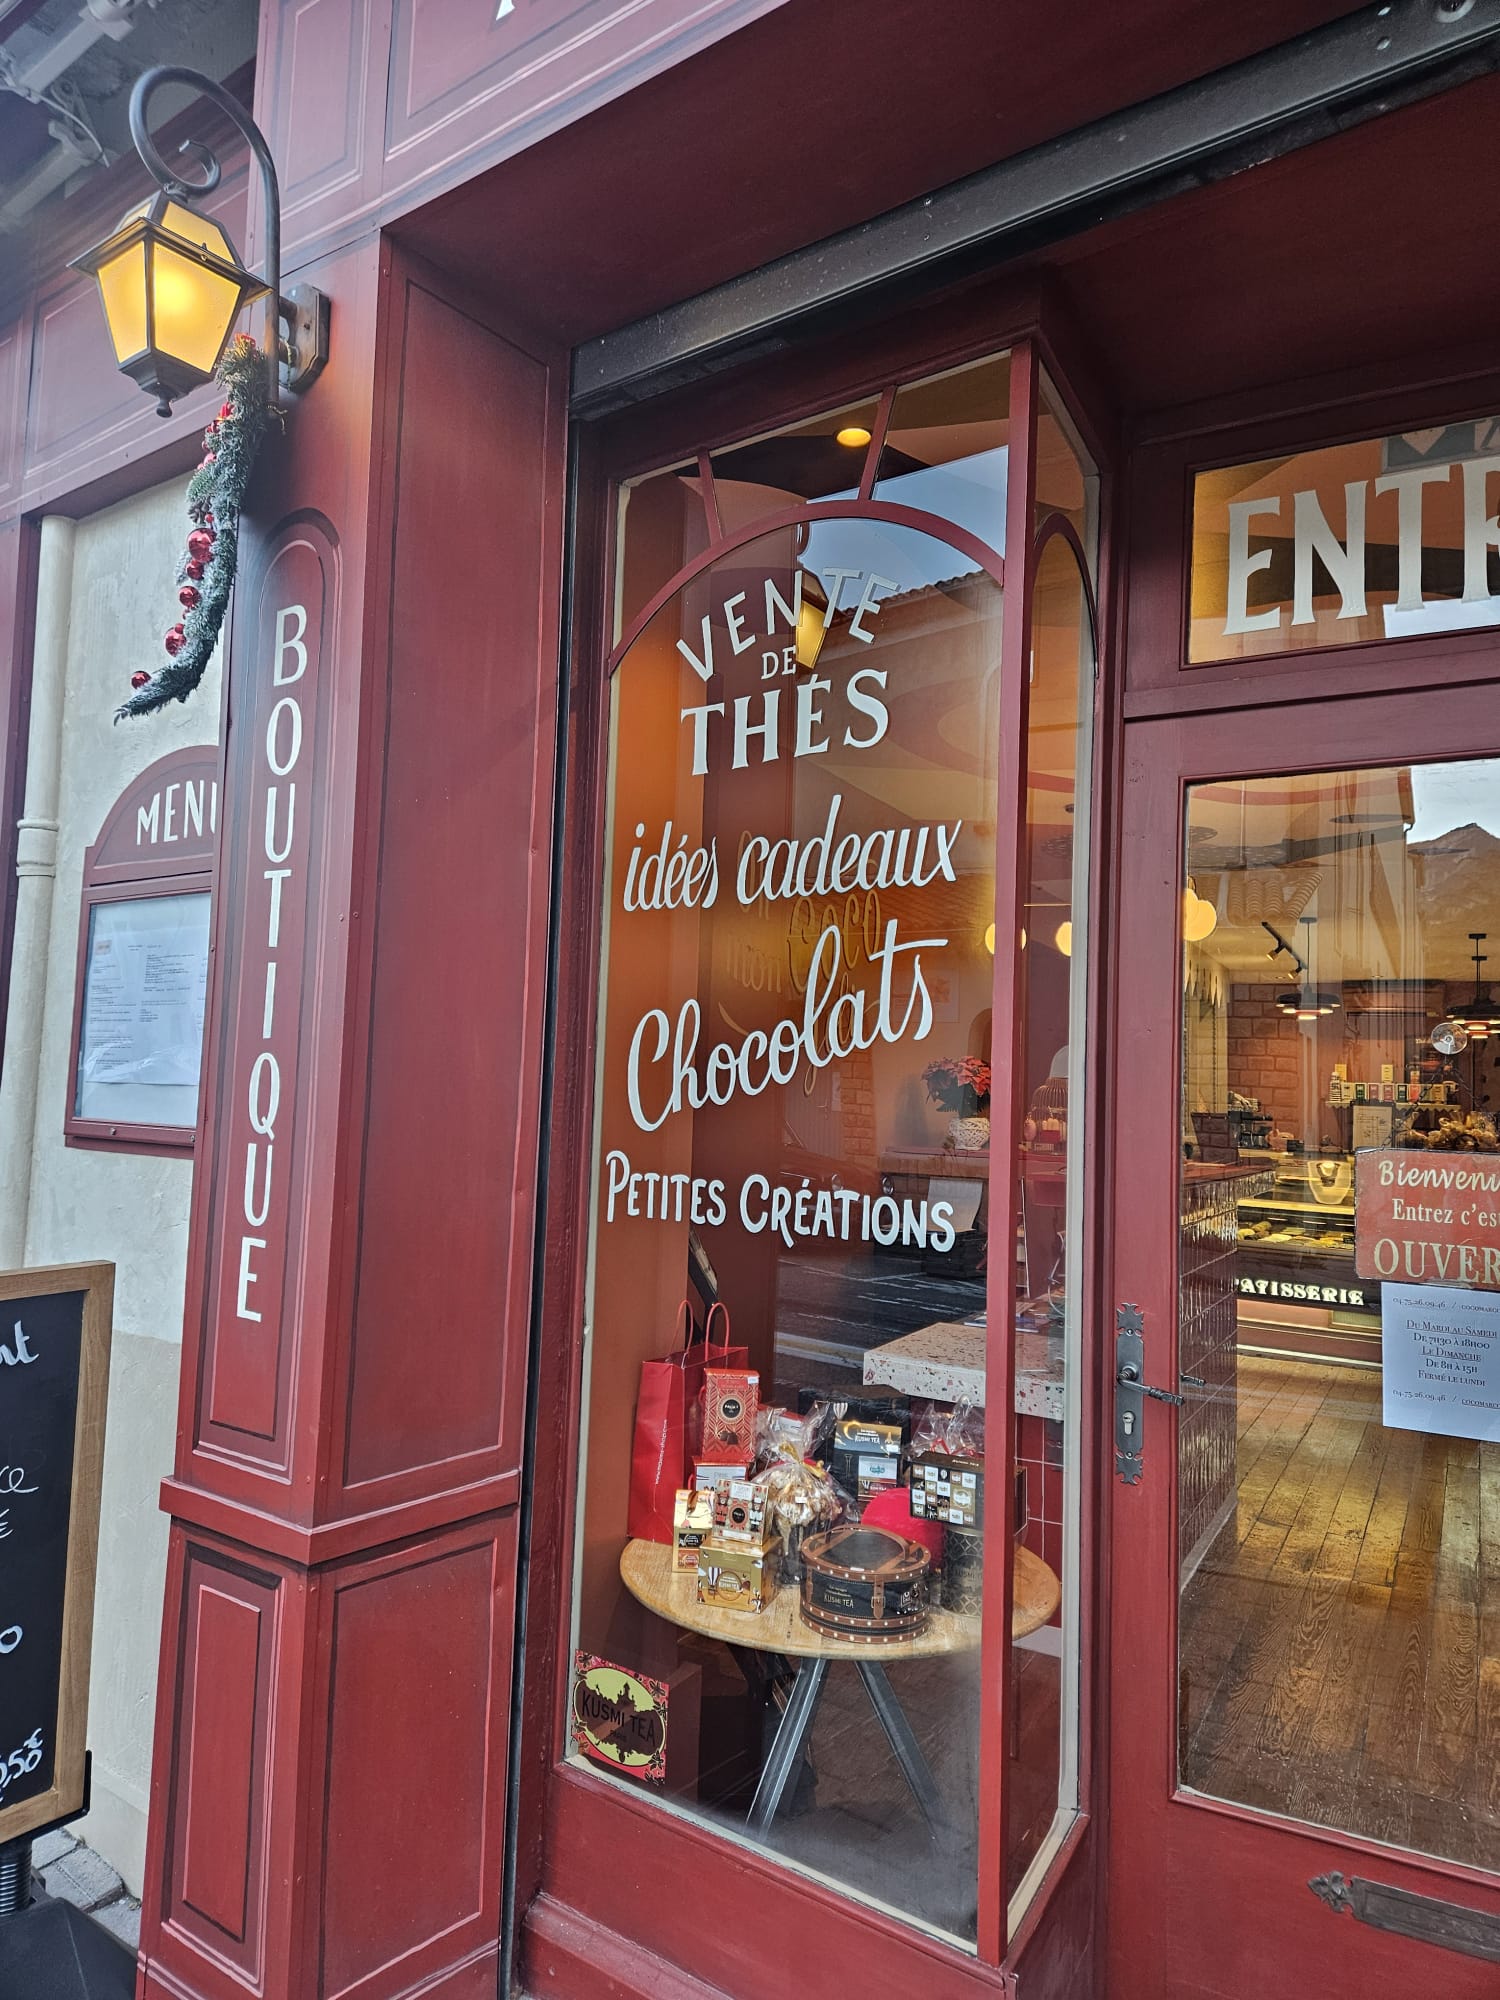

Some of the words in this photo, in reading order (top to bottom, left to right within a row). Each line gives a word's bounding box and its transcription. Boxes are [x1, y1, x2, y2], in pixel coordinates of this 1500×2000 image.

[676, 566, 901, 682] VENTE
[761, 645, 796, 680] DE
[680, 669, 889, 777] THÉS
[623, 820, 719, 913] idées
[736, 794, 963, 906] cadeaux
[236, 604, 308, 1323] BOUTIQUE
[627, 918, 949, 1133] Chocolats
[1391, 1198, 1454, 1225] Entrez
[1460, 1203, 1500, 1228] c'es
[1234, 1278, 1365, 1306] ATISSERIE
[582, 1690, 625, 1728] KUSMI
[630, 1715, 656, 1747] TEA
